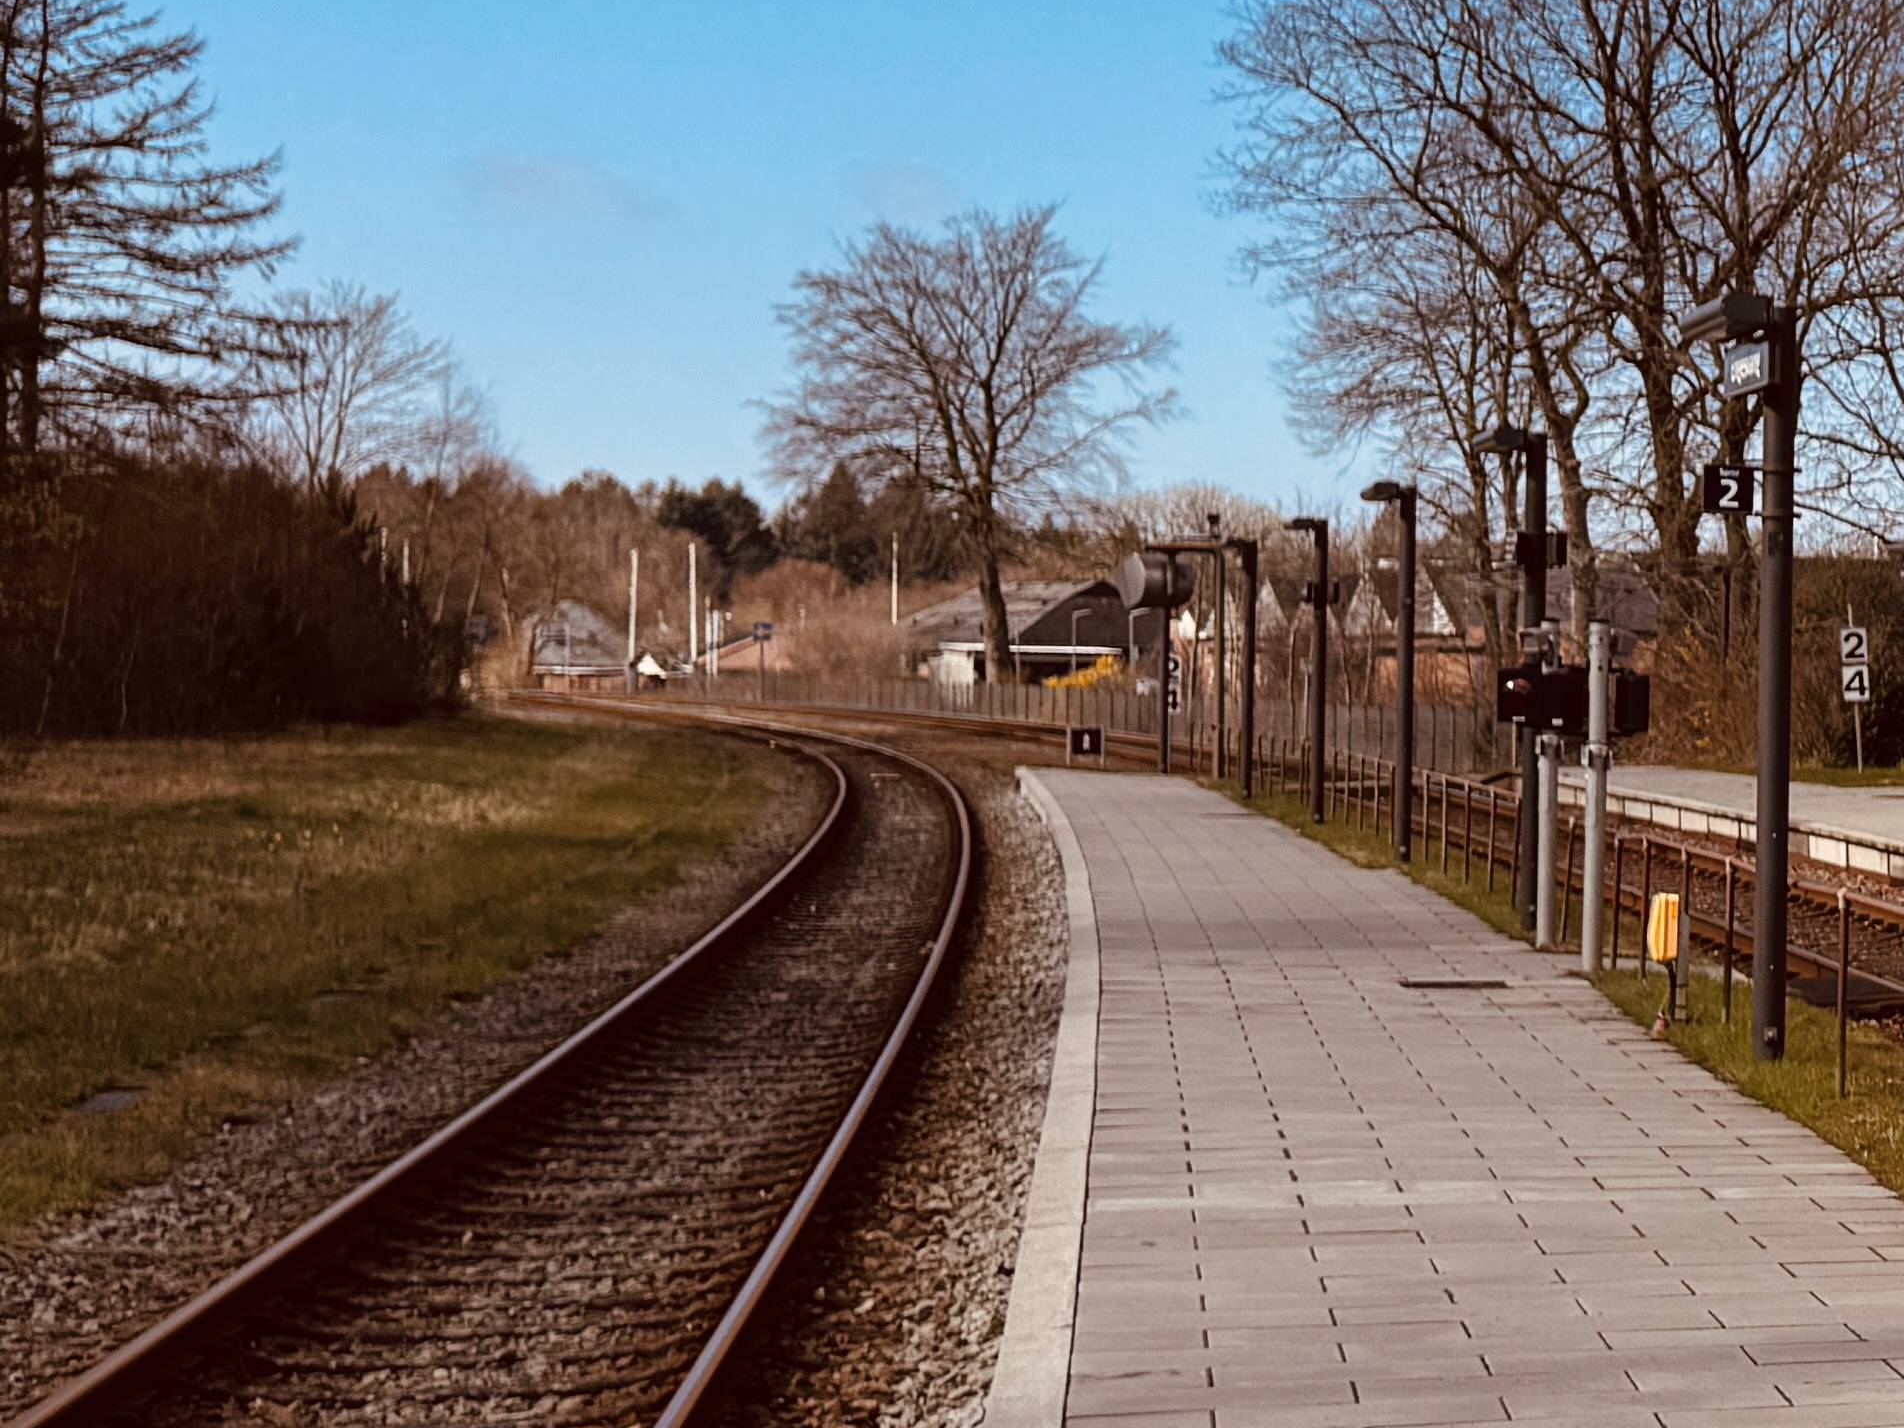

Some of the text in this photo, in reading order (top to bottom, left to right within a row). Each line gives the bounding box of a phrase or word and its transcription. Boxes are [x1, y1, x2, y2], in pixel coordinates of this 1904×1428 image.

[1718, 478, 1739, 508] 2
[1844, 632, 1865, 659] 2
[1844, 670, 1868, 696] 4
